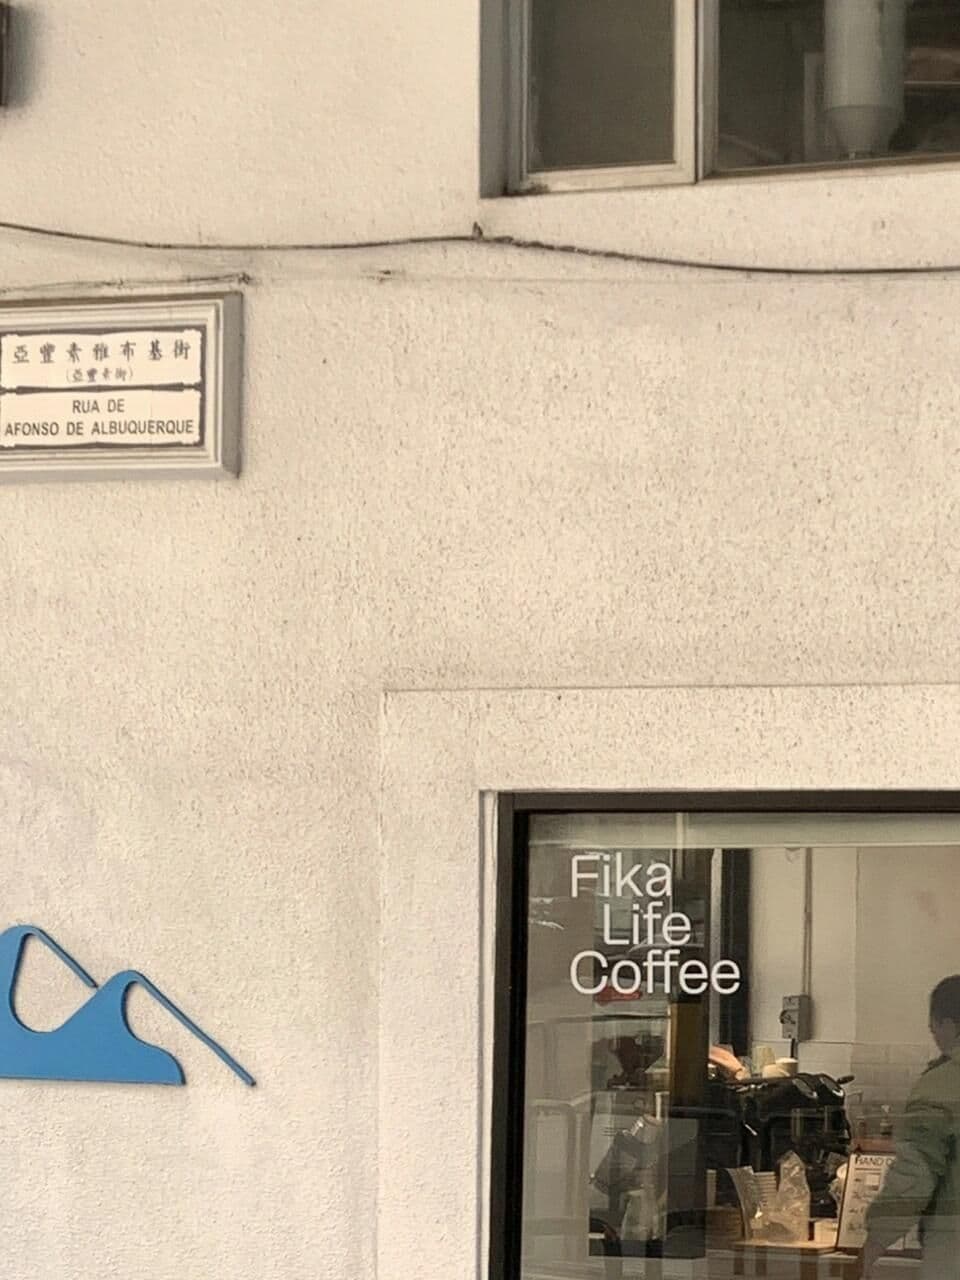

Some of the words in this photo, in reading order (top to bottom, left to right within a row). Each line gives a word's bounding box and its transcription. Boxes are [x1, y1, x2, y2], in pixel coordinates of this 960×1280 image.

[4, 421, 60, 437] AFONSO
[66, 421, 84, 436] DE
[91, 418, 194, 436] ALBUQUERQUE
[72, 399, 101, 414] RUA
[107, 398, 125, 413] DE
[571, 852, 672, 898] Fika
[603, 901, 692, 945] Life
[570, 949, 741, 995] Coffee
